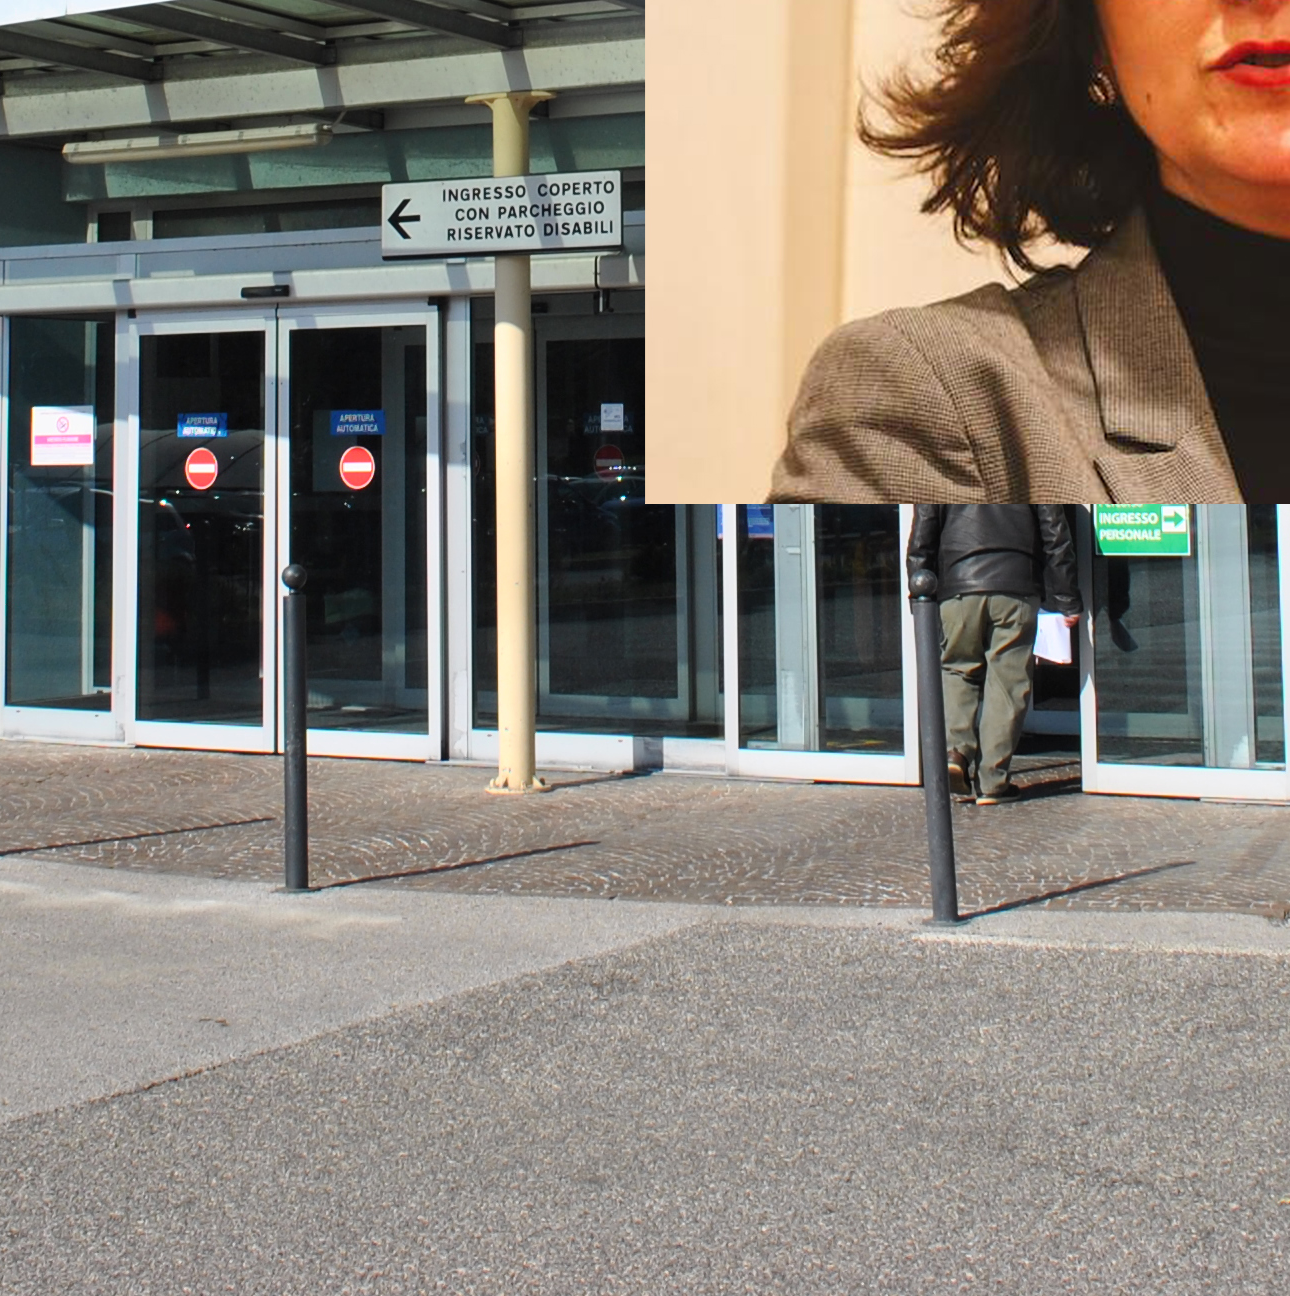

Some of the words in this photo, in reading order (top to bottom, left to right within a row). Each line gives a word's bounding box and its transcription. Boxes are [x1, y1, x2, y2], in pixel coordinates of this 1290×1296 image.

[442, 185, 526, 202] INGRESSO
[537, 180, 615, 198] COPERTO
[455, 207, 489, 221] CON
[498, 201, 605, 219] PARCHEGGIO
[447, 224, 535, 241] RISERVATO
[543, 220, 613, 237] DISABILI
[340, 413, 375, 422] APERTURA
[336, 423, 379, 433] AUTOMATICA
[1099, 512, 1159, 525] INGRESSO
[1099, 528, 1162, 541] PERSONALE
